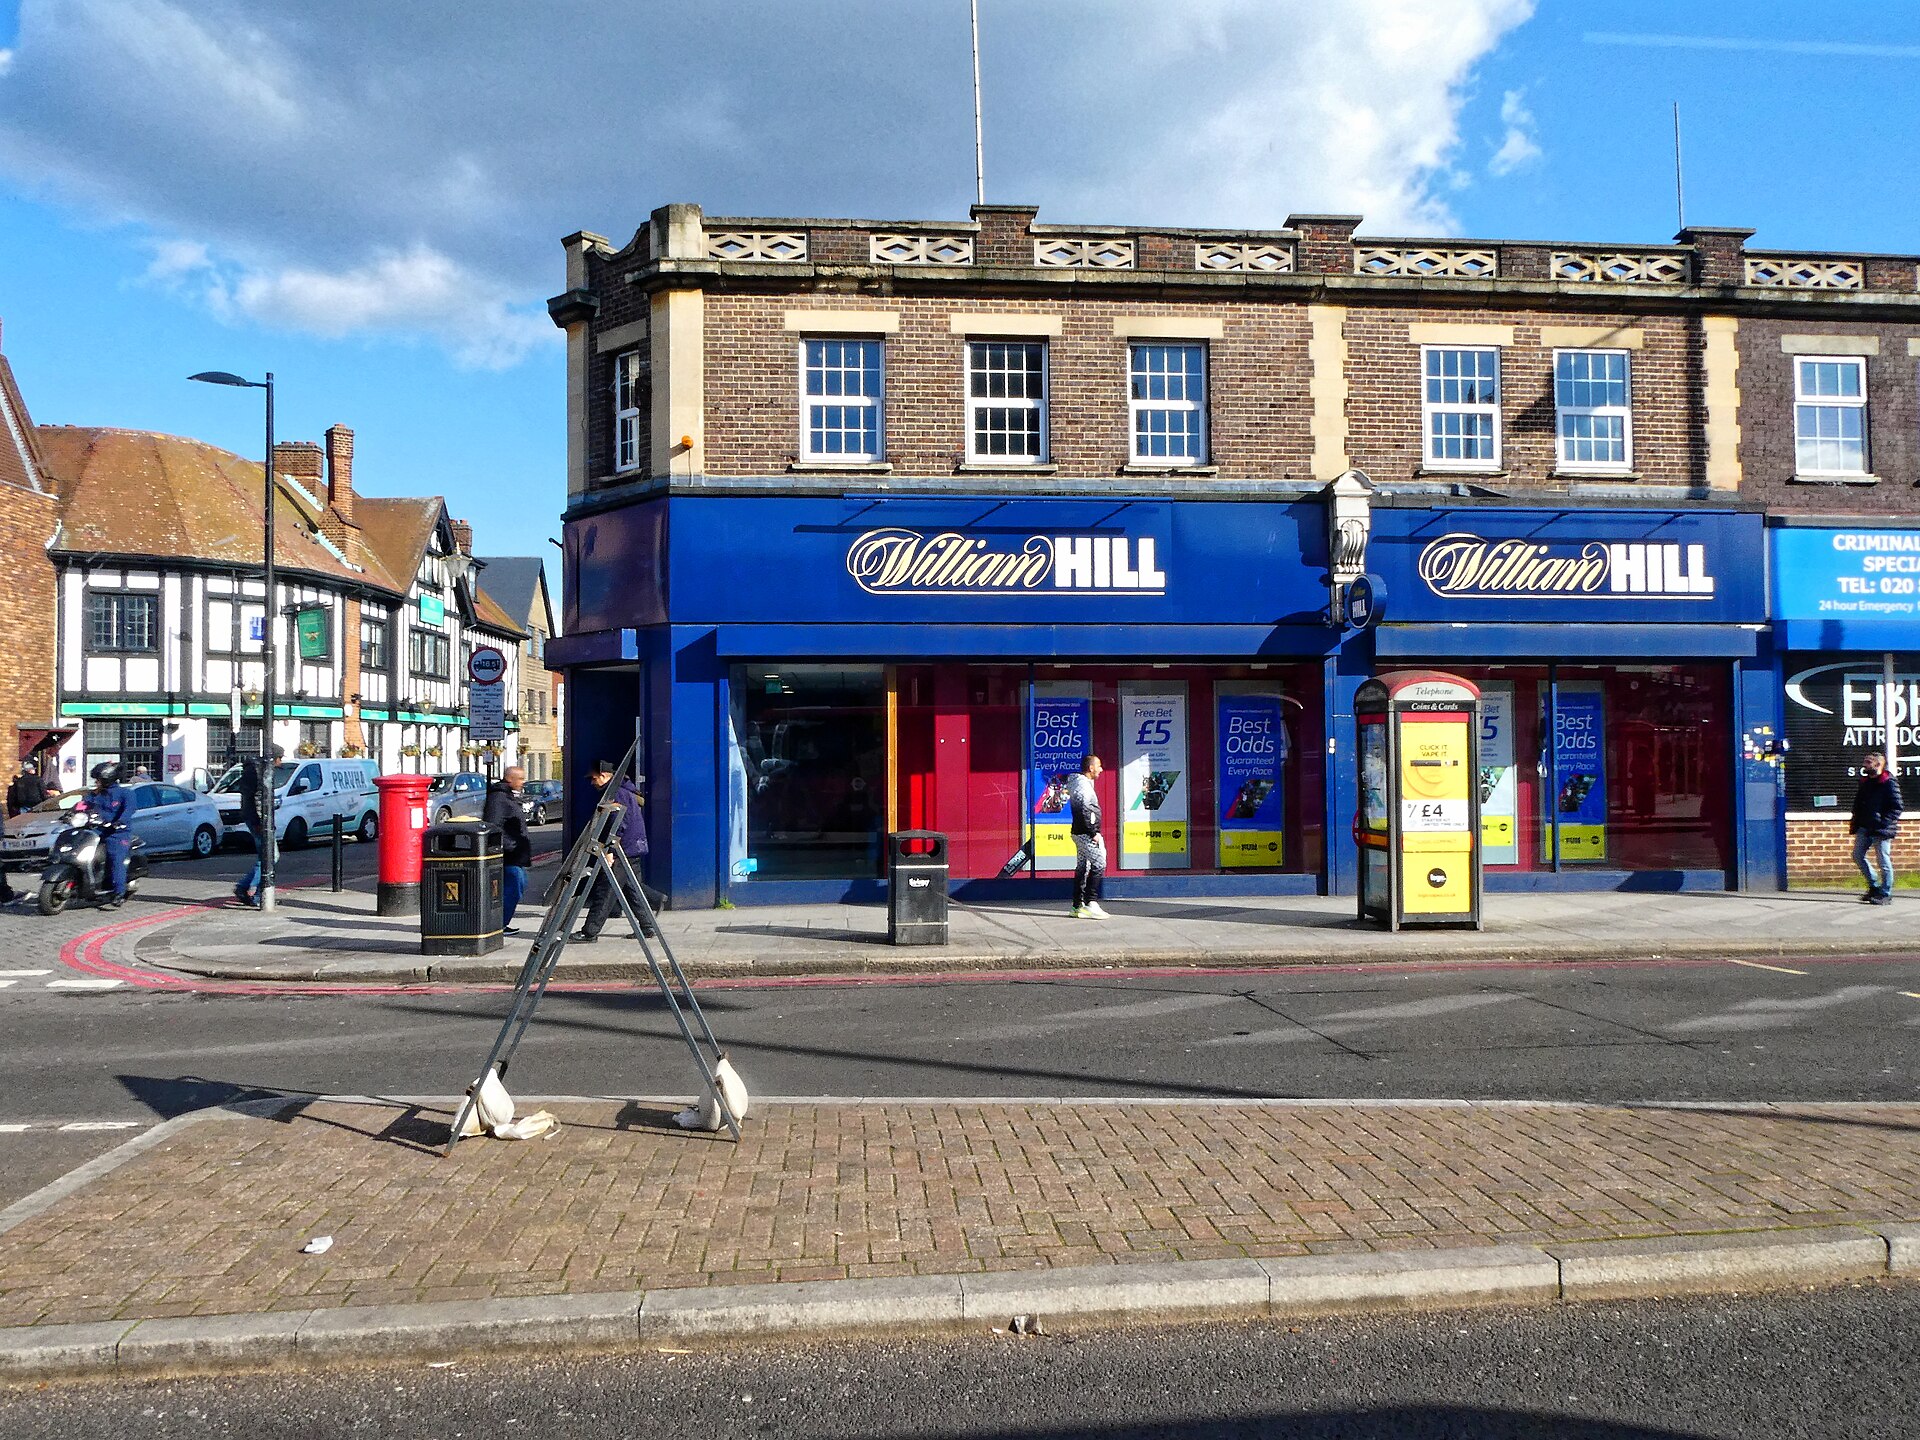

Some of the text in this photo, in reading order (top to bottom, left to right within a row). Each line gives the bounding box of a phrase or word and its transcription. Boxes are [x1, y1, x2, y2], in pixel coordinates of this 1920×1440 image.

[847, 527, 1166, 589] William HILL
[1418, 532, 1714, 592] William HILL
[1837, 577, 1876, 593] TEL:
[1880, 577, 1914, 594] 020
[1352, 599, 1367, 618] HILL
[1819, 600, 1914, 614] 24 hour Emergency
[1416, 687, 1454, 697] Telephone
[1134, 708, 1173, 717] Free Bet
[1411, 702, 1458, 711] Coins & Cards
[1483, 704, 1500, 714] Bet
[1036, 711, 1079, 728] Best
[1229, 717, 1271, 734] Best
[1480, 715, 1499, 740] 5
[1556, 713, 1593, 730] Best
[1033, 730, 1082, 747] Odds
[1135, 719, 1173, 745] £5
[1226, 736, 1275, 753] Odds
[1226, 756, 1275, 765] Guaranteed
[1557, 752, 1597, 760] uaranteed
[1035, 761, 1080, 771] Every Race
[1228, 767, 1273, 777] Every Race
[1557, 763, 1575, 772] very
[331, 771, 368, 789] PRAVHA
[1421, 804, 1443, 817] £4
